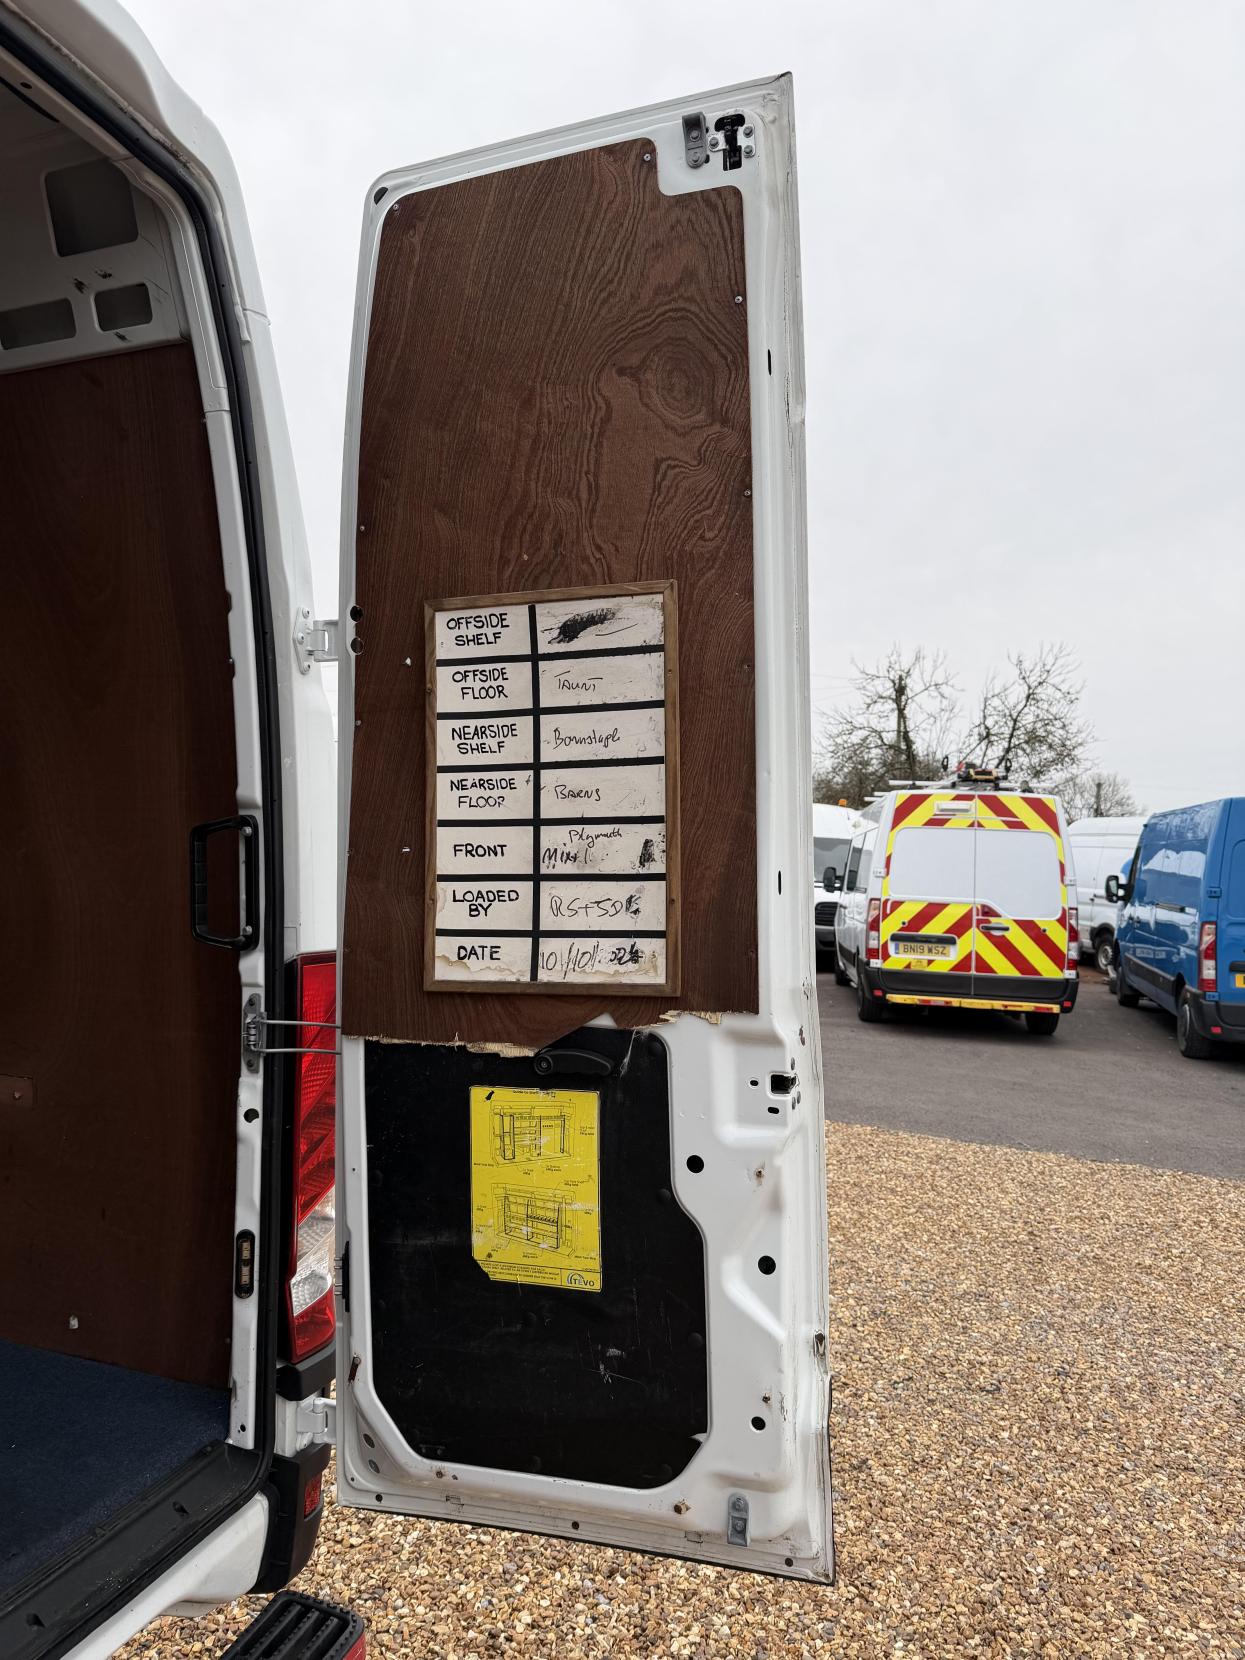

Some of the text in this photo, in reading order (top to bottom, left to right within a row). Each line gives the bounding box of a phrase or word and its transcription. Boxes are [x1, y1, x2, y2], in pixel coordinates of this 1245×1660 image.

[446, 612, 510, 630] OFFSIDE
[455, 632, 502, 647] SHELF
[452, 667, 509, 684] OFFSIDE
[461, 685, 508, 700] FLOOR
[451, 723, 518, 740] NEARSIDE
[457, 741, 505, 755] SHELF
[450, 777, 517, 791] NEARSIDE
[453, 844, 507, 858] FRONT
[452, 889, 520, 903] LOADED
[468, 903, 493, 917] BY
[457, 946, 501, 961] DATE
[903, 943, 925, 954] BN19
[573, 1278, 595, 1287] TEVO
